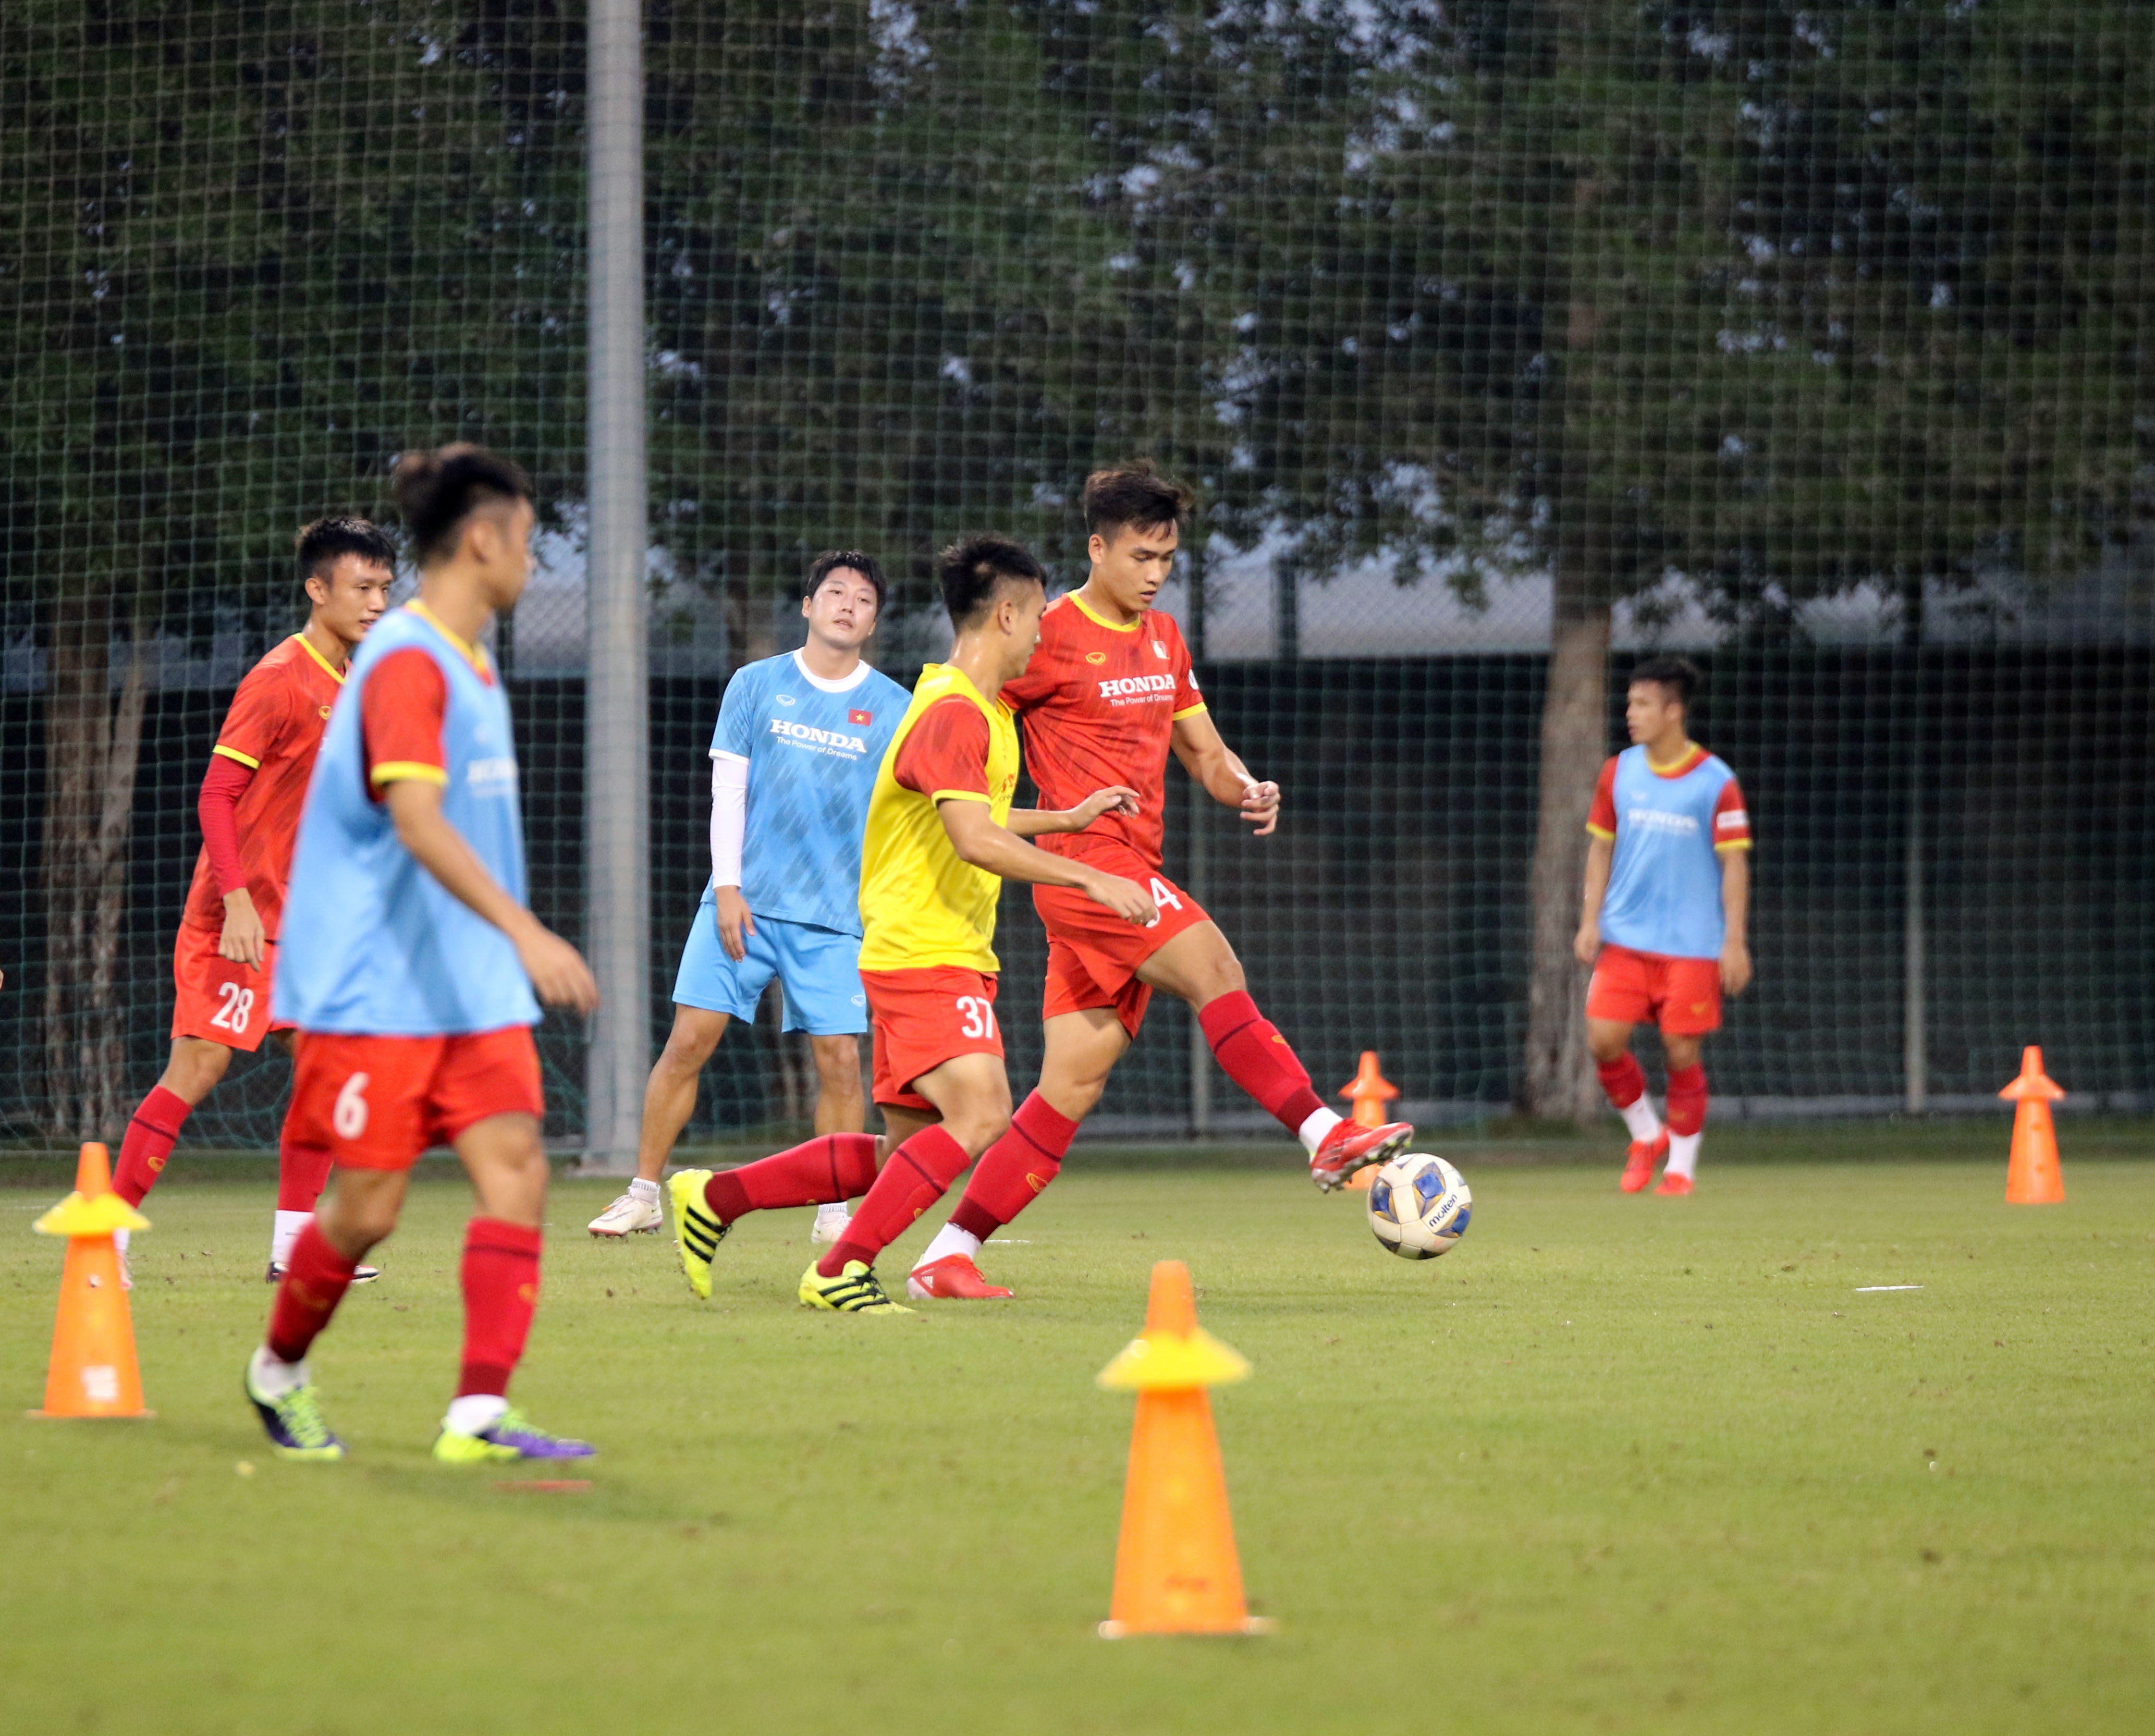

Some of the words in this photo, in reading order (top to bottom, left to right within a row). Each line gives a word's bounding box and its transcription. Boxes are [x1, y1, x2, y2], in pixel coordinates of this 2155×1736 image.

[1098, 674, 1177, 698] HONDA
[1126, 696, 1146, 705] Power
[770, 719, 866, 753] HONDA
[776, 736, 791, 745] The
[791, 740, 816, 751] Power
[827, 748, 858, 761] Dreams
[210, 982, 254, 1033] 28
[956, 995, 993, 1038] 37
[332, 1071, 370, 1141] 6
[1429, 1194, 1458, 1227] molten
